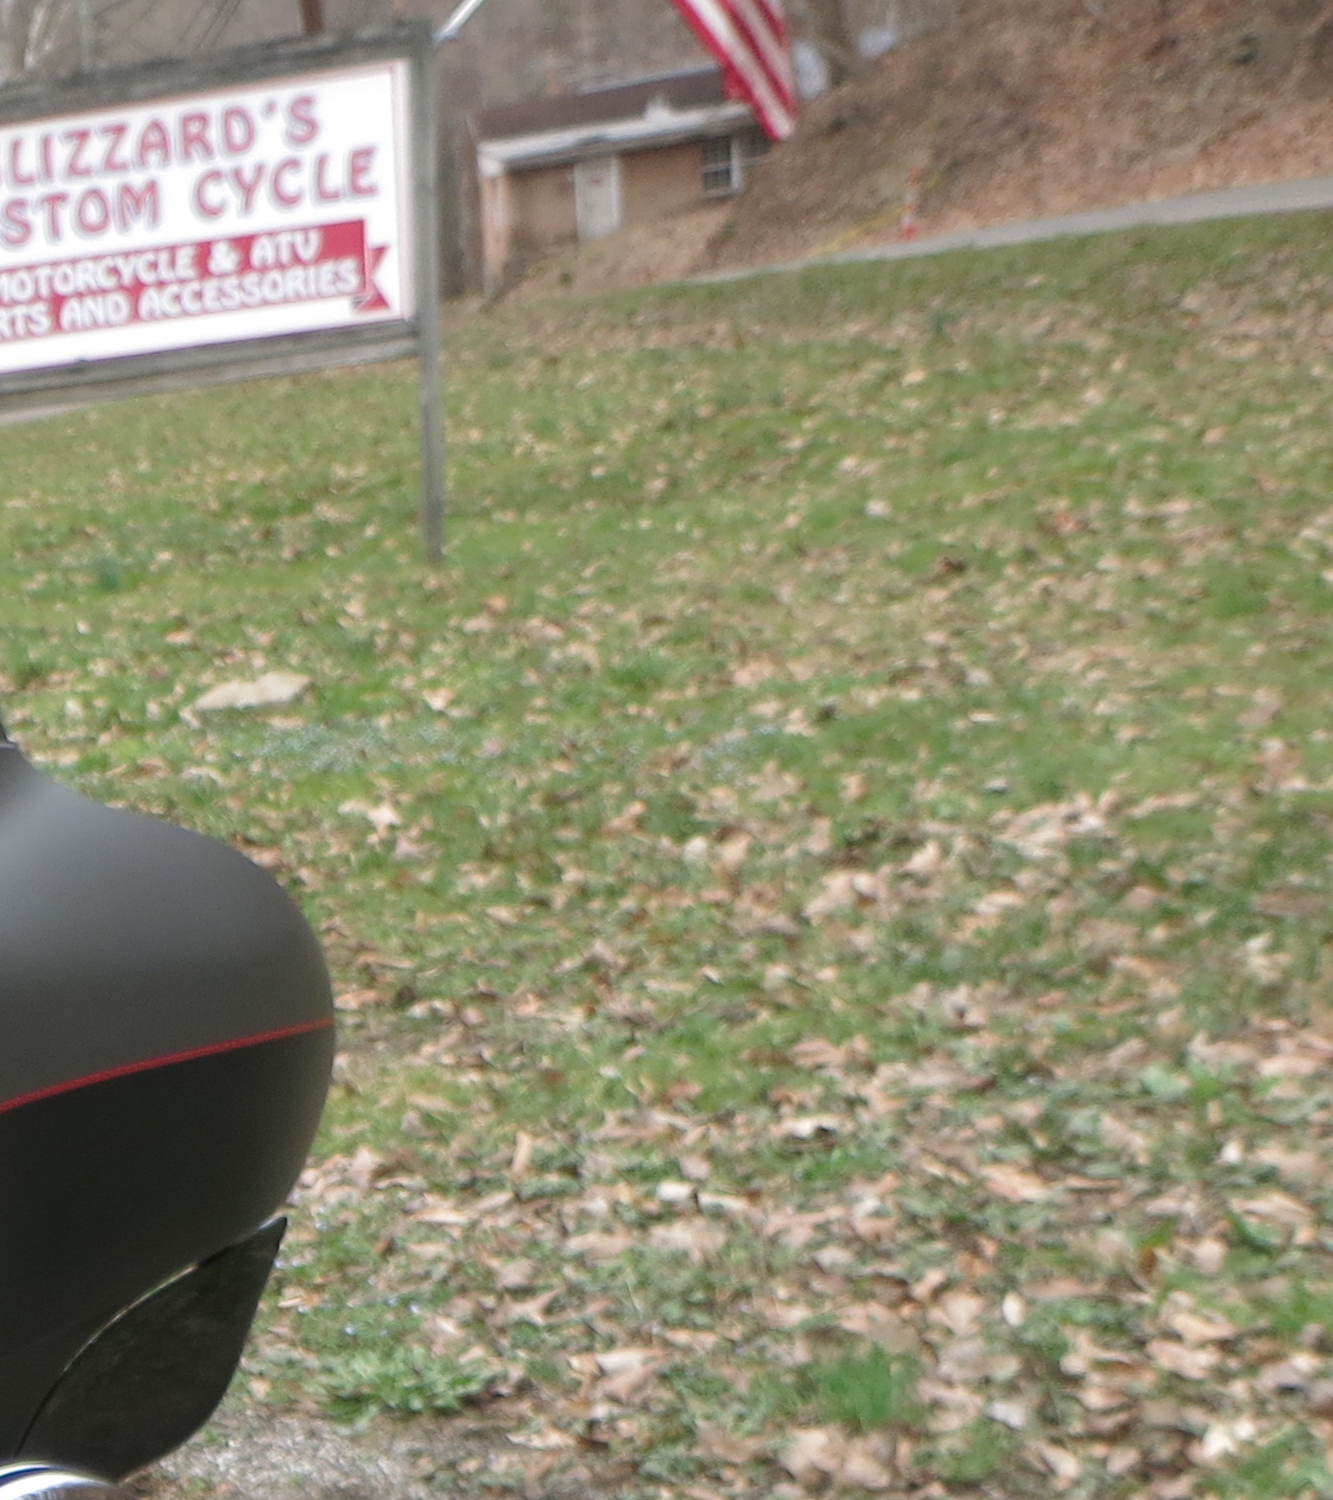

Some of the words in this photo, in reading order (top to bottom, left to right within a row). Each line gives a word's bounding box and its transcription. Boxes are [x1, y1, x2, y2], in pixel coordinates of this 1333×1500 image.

[194, 147, 378, 218] CYCLE
[209, 240, 239, 273] &
[250, 227, 319, 268] ATV
[60, 295, 129, 330] AND
[137, 262, 359, 320] ACCESSORIES
